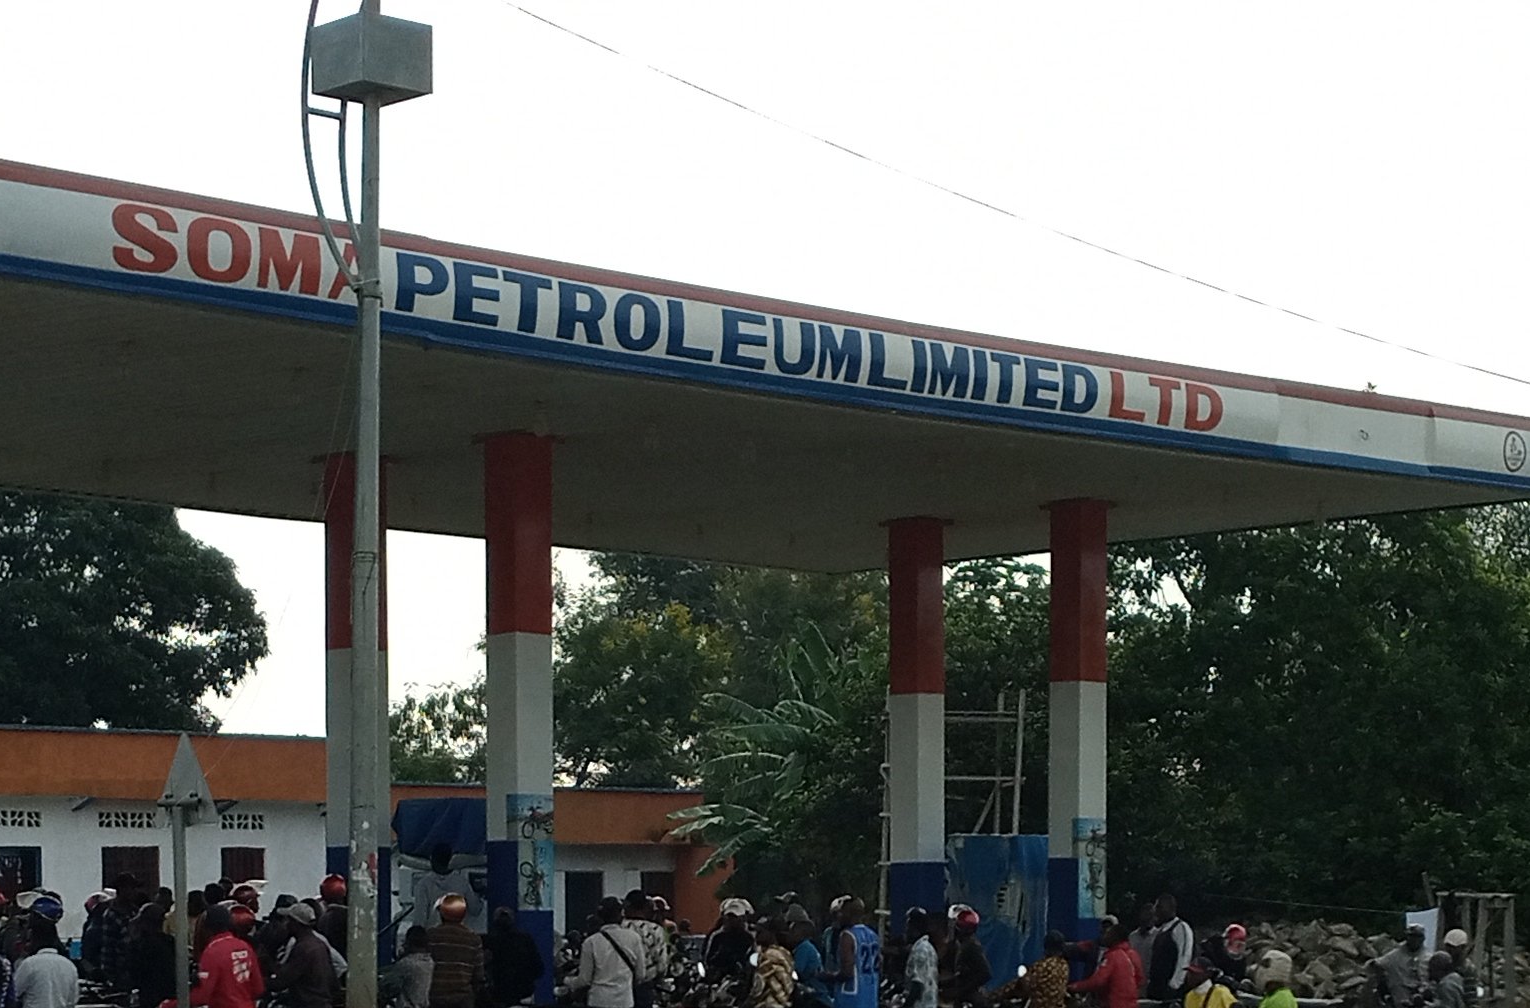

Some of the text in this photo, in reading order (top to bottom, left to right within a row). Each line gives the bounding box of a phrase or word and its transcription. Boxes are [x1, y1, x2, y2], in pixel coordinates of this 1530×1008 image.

[395, 252, 864, 383] PETROLEUM
[867, 331, 1099, 415] LIMITED
[1108, 371, 1224, 432] LTD
